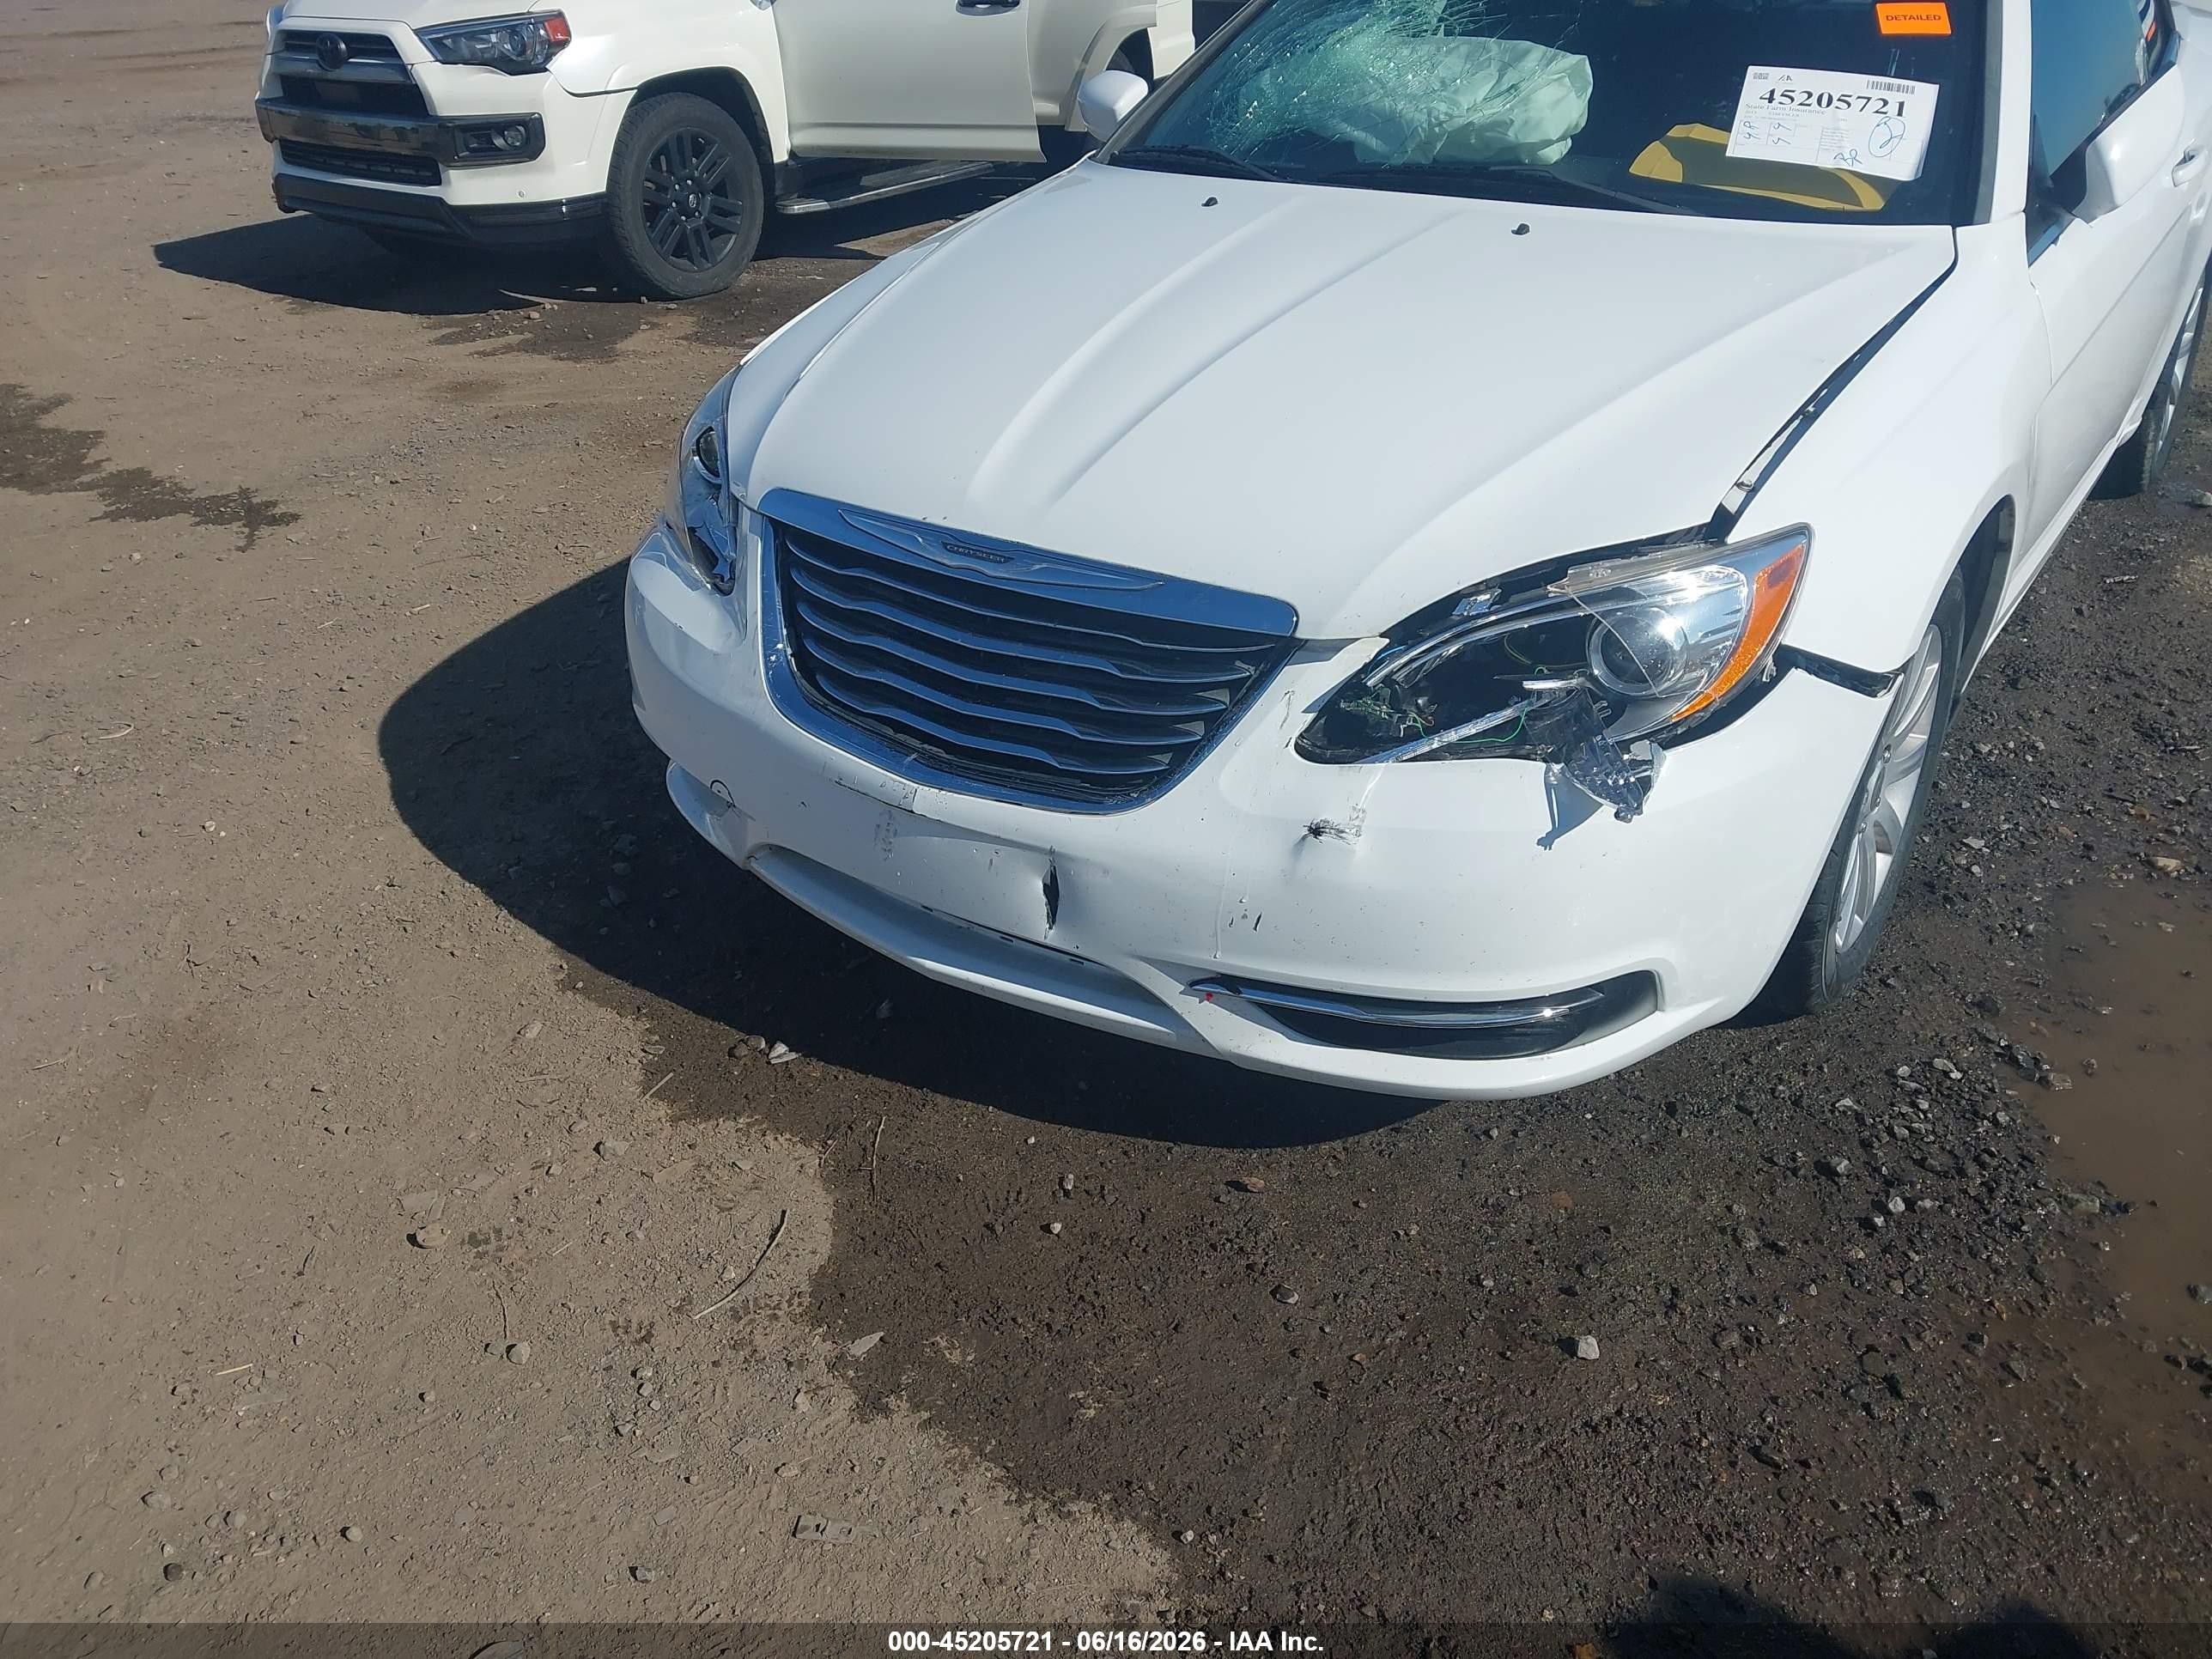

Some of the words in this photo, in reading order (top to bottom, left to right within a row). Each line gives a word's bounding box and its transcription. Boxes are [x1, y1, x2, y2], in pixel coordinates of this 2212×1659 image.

[1759, 88, 1906, 118] 45205721
[1788, 106, 1826, 115] Insurance
[946, 544, 1006, 563] CHRYSLER
